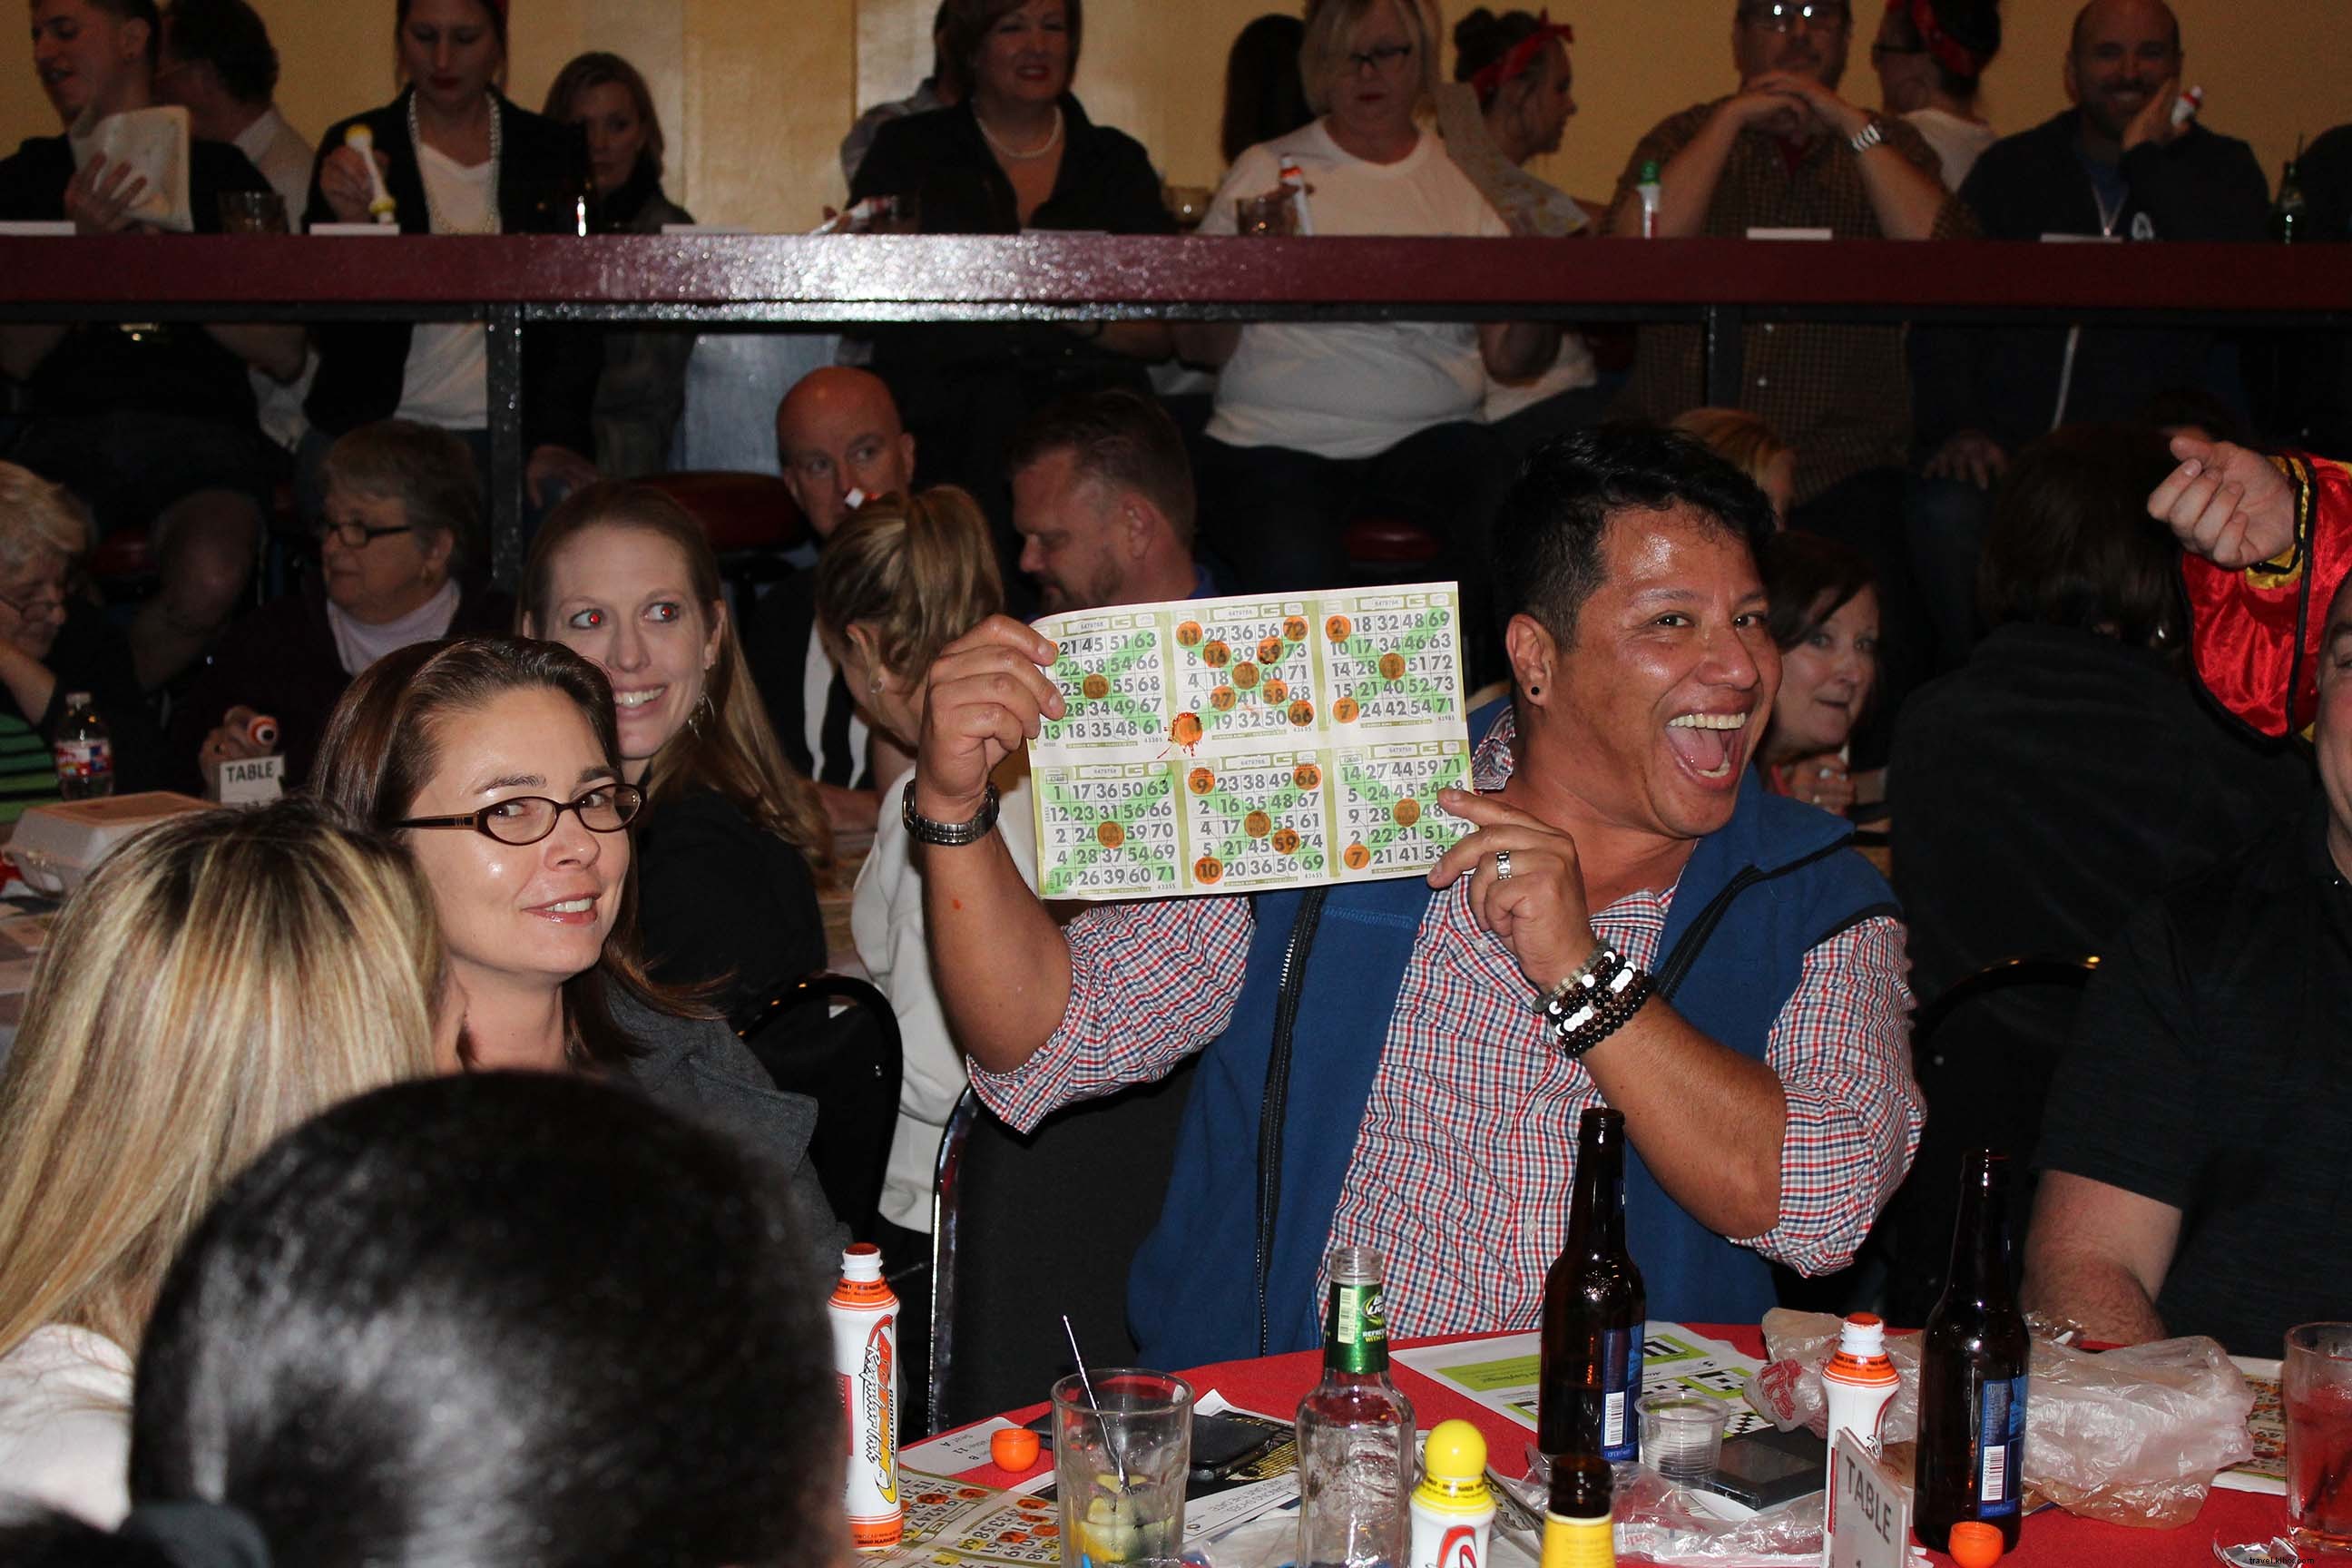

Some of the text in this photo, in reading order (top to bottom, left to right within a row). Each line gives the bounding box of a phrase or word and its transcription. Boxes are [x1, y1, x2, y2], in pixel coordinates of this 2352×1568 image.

[1205, 627, 1227, 642] 22
[1231, 625, 1253, 641] 36
[1258, 623, 1279, 638] 56
[1354, 617, 1371, 632] 18
[1377, 615, 1398, 631] 32
[1403, 613, 1424, 628] 48
[1429, 612, 1450, 627] 69
[1060, 632, 1156, 655] 21 45 51 63
[1187, 652, 1196, 665] 8
[1233, 646, 1255, 662] 39
[1285, 643, 1307, 659] 73
[1330, 633, 1451, 655] 10 17 34 46 63
[1058, 655, 1159, 676] 22 38 54 66
[1332, 655, 1452, 677] 14 28 51 72
[1061, 676, 1160, 696] 25 55 68
[1189, 665, 1307, 688] 4 18 60 71
[1335, 677, 1454, 698] 15 21 40 52 73
[1089, 701, 1110, 716] 34
[1114, 700, 1136, 714] 49
[1140, 698, 1161, 712] 67
[1191, 687, 1310, 710] 6 27 41 58 68
[1361, 702, 1382, 718] 24
[1386, 701, 1406, 716] 42
[1411, 700, 1432, 714] 54
[1436, 699, 1454, 712] 71
[1044, 720, 1161, 740] 13 18 35 48 61
[1213, 715, 1232, 730] 19
[1239, 713, 1262, 727] 32
[1266, 710, 1287, 725] 50
[226, 761, 274, 782] TABLE
[1343, 760, 1460, 781] 14 27 44 59 71
[1054, 780, 1169, 799] 1 17 36 50 63
[1197, 771, 1318, 792] 9 23 38 49 66
[1348, 782, 1439, 802] 5 24 45 54
[1051, 802, 1171, 821] 12 23 31 56 66
[1200, 792, 1318, 814] 2 16 35 48 67
[1349, 804, 1443, 823] 9 28 48
[1056, 823, 1173, 843] 2 24 59 70
[1200, 814, 1318, 835] 4 17 55 61
[1350, 823, 1470, 845] 2 22 31 51 72
[1057, 845, 1175, 865] 4 28 37 54 69
[1204, 835, 1322, 857] 5 21 45 59 74
[1351, 845, 1445, 866] 7 21 41 53
[1055, 867, 1174, 887] 14 26 39 60 71
[1201, 856, 1324, 877] 10 20 36 56 69
[859, 1346, 885, 1463] Regular Ink
[1846, 1455, 1891, 1544] TABLE
